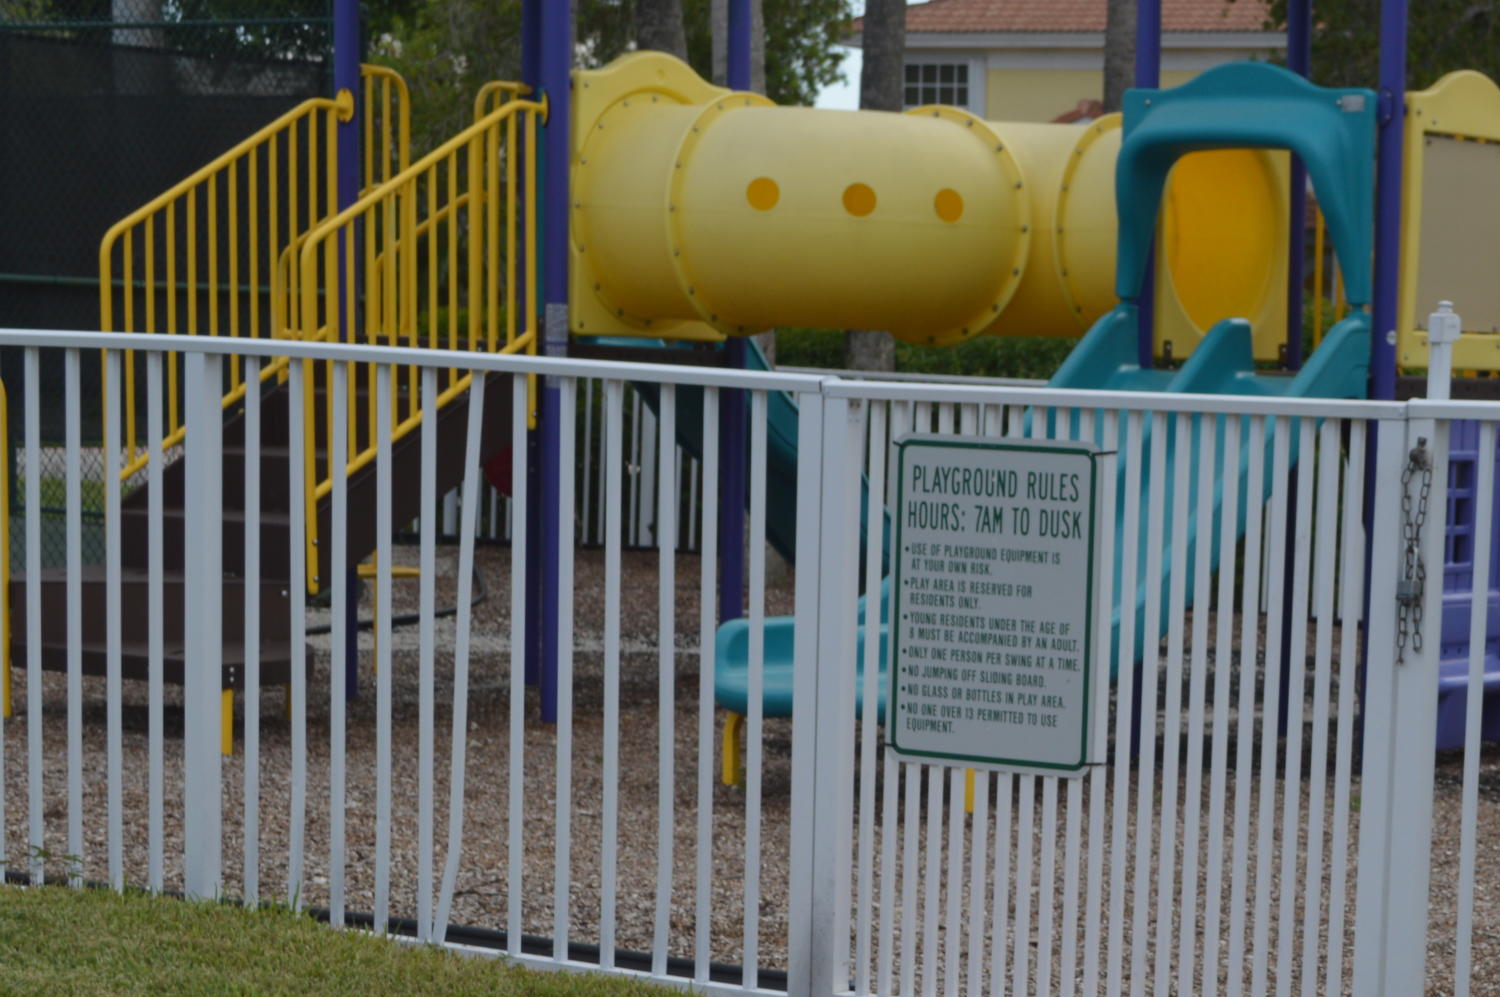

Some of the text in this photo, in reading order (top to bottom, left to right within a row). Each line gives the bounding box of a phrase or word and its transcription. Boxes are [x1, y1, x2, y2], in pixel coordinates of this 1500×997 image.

[912, 465, 1079, 502] PLAYGROUND RULES
[908, 501, 1082, 539] HOURS: 7AM TO DUSK
[912, 543, 1061, 565] USE OF PLAYGROUND EQUIPMENT IS
[912, 558, 922, 570] AT
[924, 559, 944, 572] YOUR
[948, 561, 967, 574] OWN
[910, 577, 1032, 598] PLAY AREA IS RESERVED FOR
[910, 593, 955, 608] RESIDENTS
[910, 612, 1070, 635] YOUNG RESIDENTS UNDER THE AGE OF
[918, 628, 940, 641] MUST
[944, 630, 953, 642] BE
[958, 631, 1017, 648] ACCOMPANIED
[1022, 636, 1031, 649] BY
[1036, 637, 1047, 650] AN
[908, 646, 929, 659] ONLY
[931, 648, 946, 660] ONE
[951, 649, 982, 663] PERSON
[986, 652, 1000, 665] PER
[1005, 654, 1032, 667] SWING
[1036, 656, 1045, 669] AT
[1050, 657, 1054, 670] A
[908, 665, 919, 677] NO
[922, 666, 958, 680] JUMPING
[962, 669, 976, 682] OFF
[980, 670, 1012, 685] SLIDING
[907, 684, 918, 696] NO
[922, 685, 948, 698] GLASS
[952, 687, 962, 699] OR
[966, 688, 1002, 703] BOTTLES
[1005, 691, 1014, 704] IN
[1018, 692, 1037, 706] PLAY
[907, 702, 918, 714] NO
[922, 704, 936, 716] ONE
[941, 705, 962, 719] OVER
[977, 708, 1023, 725] PERMITTED
[1028, 713, 1037, 726] TO
[1041, 714, 1057, 728] USE
